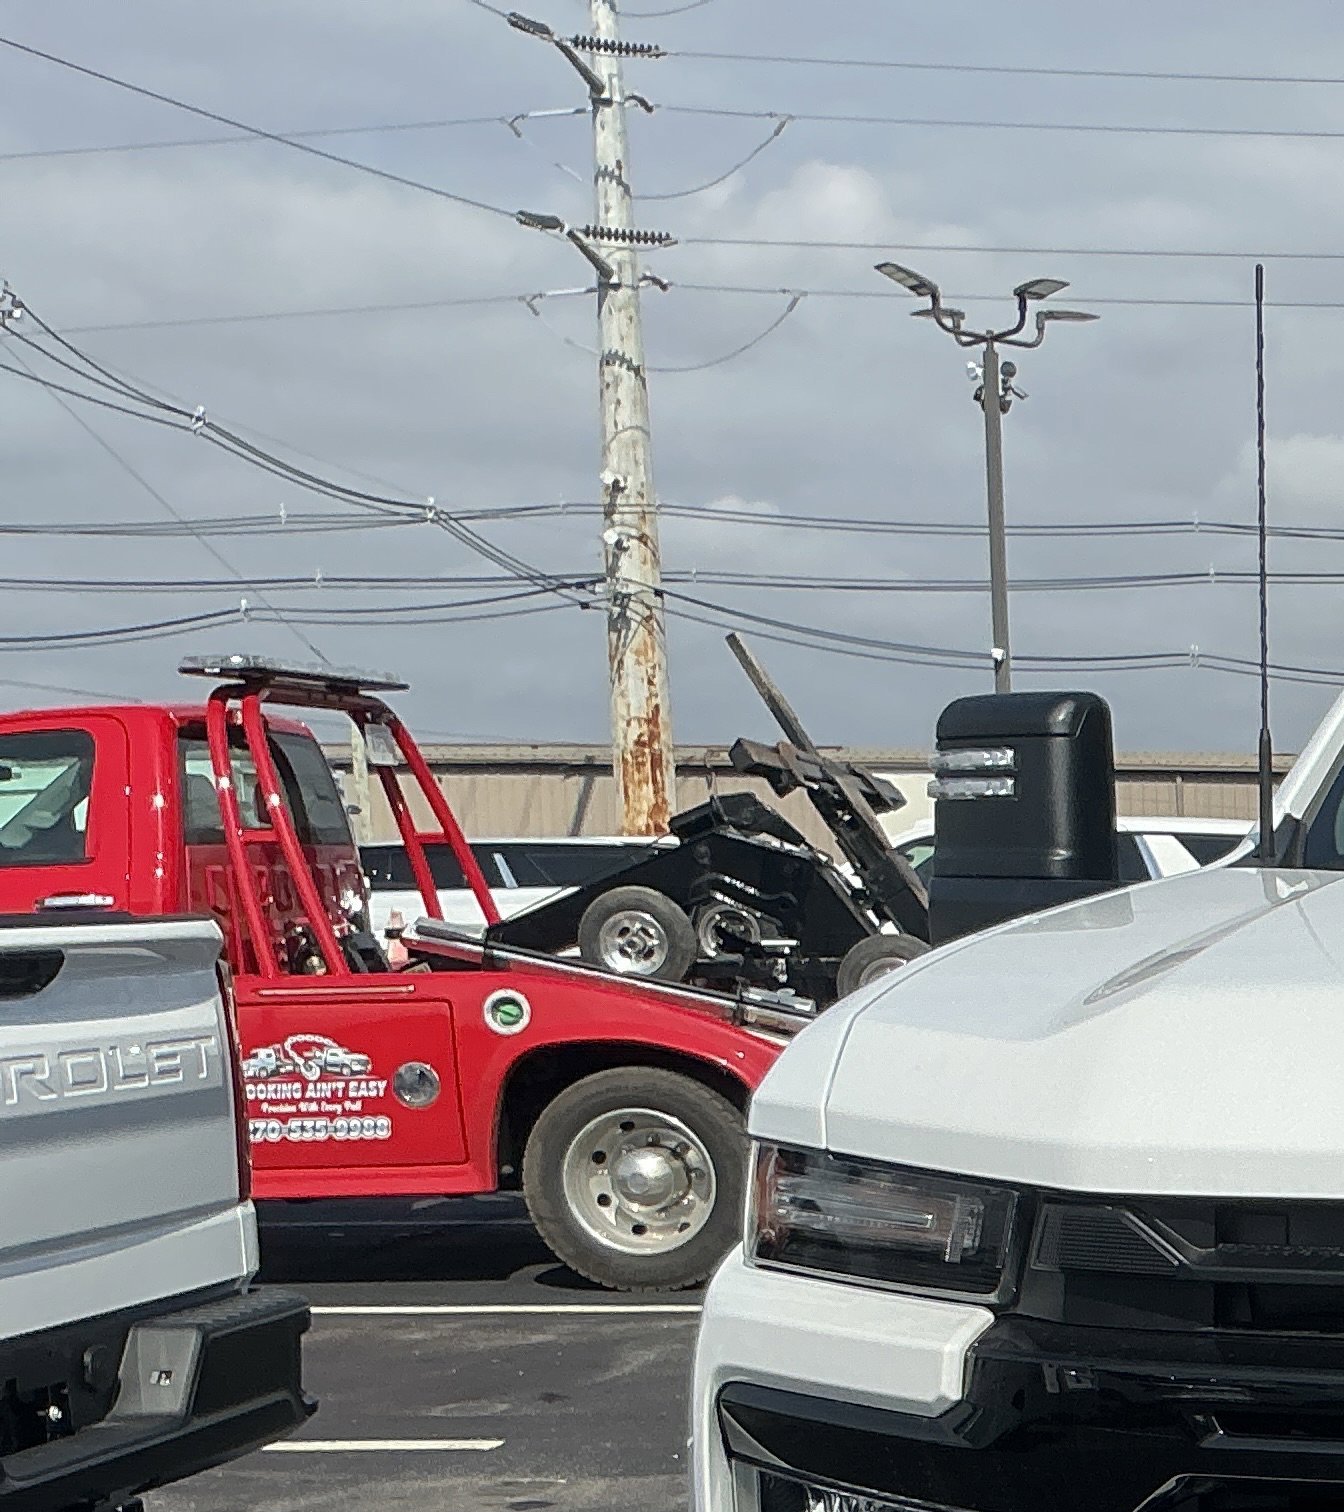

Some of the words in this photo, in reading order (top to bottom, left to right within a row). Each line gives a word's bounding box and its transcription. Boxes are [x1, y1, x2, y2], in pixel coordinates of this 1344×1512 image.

[0, 1036, 214, 1105] ROLET
[304, 1081, 346, 1099] AIN'T
[348, 1080, 388, 1098] EASY
